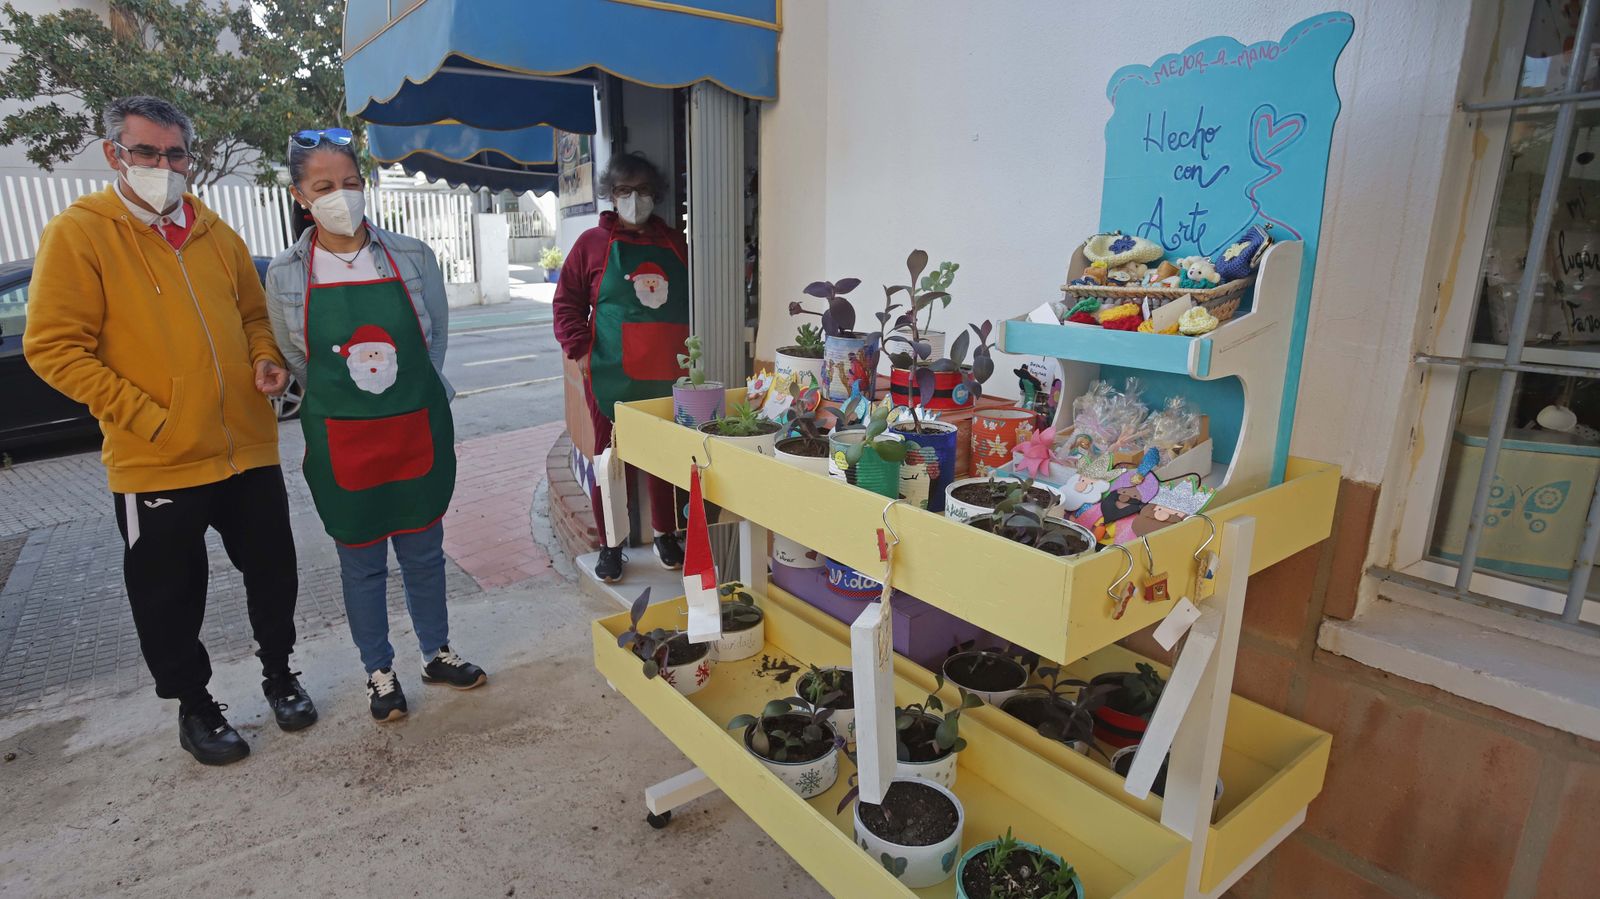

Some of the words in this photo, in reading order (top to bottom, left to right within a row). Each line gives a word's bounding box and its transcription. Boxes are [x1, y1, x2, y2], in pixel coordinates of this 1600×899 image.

[1236, 43, 1281, 70] MANO
[1143, 105, 1222, 161] Hecho
[1173, 163, 1230, 189] con
[1136, 196, 1208, 257] Arte
[829, 568, 878, 590] Vida
